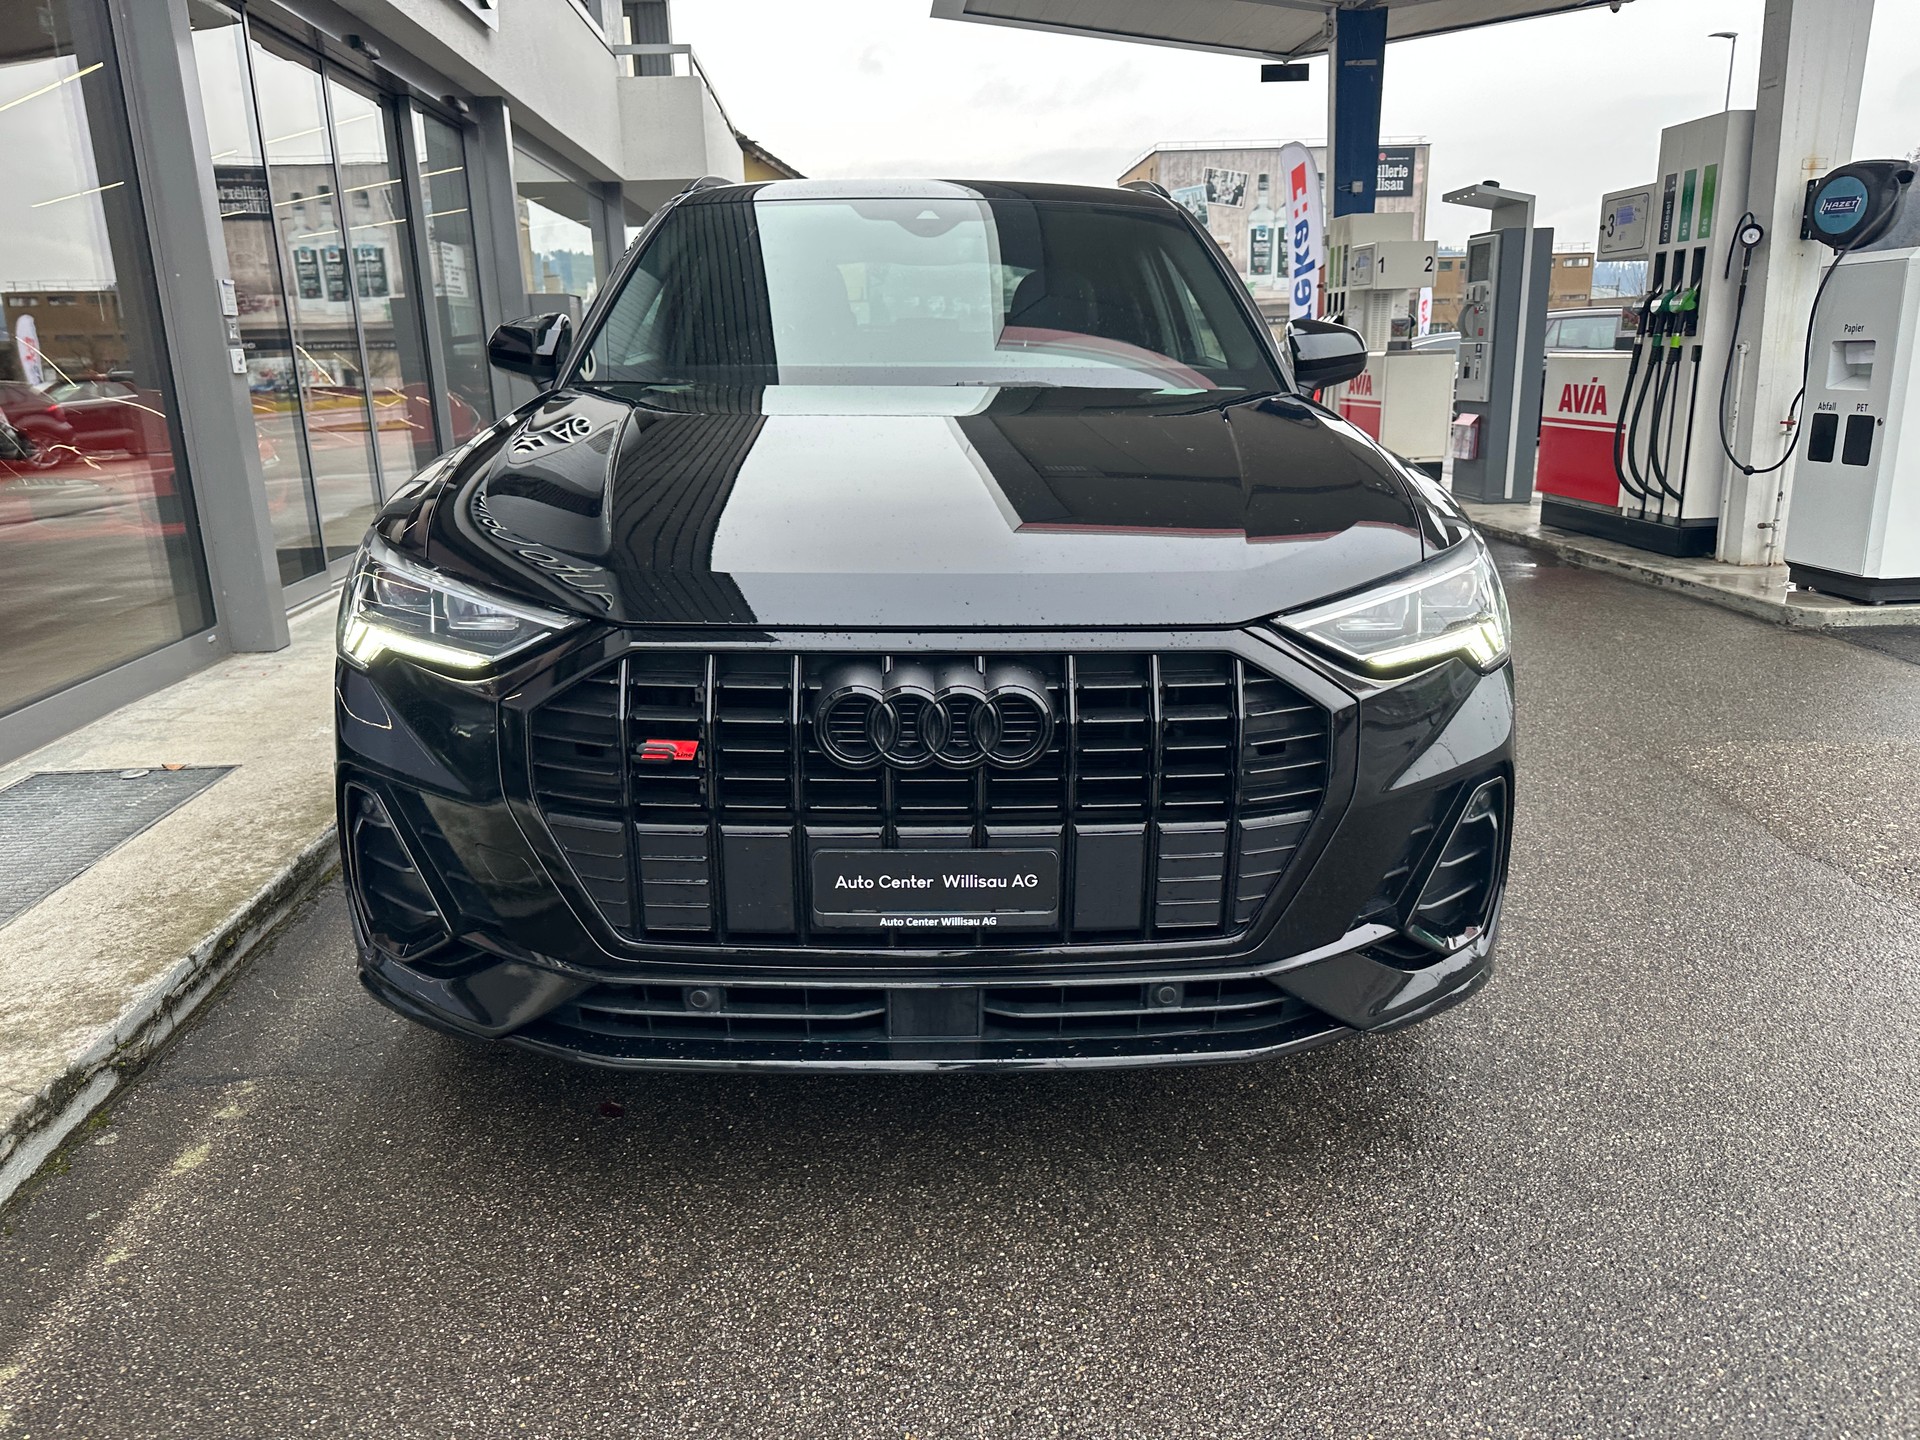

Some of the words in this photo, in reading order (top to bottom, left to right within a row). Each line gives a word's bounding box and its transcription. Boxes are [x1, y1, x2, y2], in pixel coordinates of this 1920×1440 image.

[1376, 164, 1409, 178] illerie
[1375, 178, 1404, 191] lisau
[1823, 200, 1858, 211] HAZET
[1607, 213, 1615, 238] 3
[1378, 256, 1385, 274] 1
[1424, 255, 1434, 273] 2
[1843, 323, 1865, 335] Papier
[1817, 402, 1837, 412] Abfall
[1855, 403, 1869, 413] PET
[835, 875, 875, 889] Auto
[878, 874, 934, 889] Center
[942, 874, 1008, 888] Willisau
[1011, 874, 1039, 888] AG
[879, 917, 904, 927] Auto
[906, 917, 938, 927] Center
[940, 917, 980, 926] Willisau
[981, 917, 997, 926] AG
